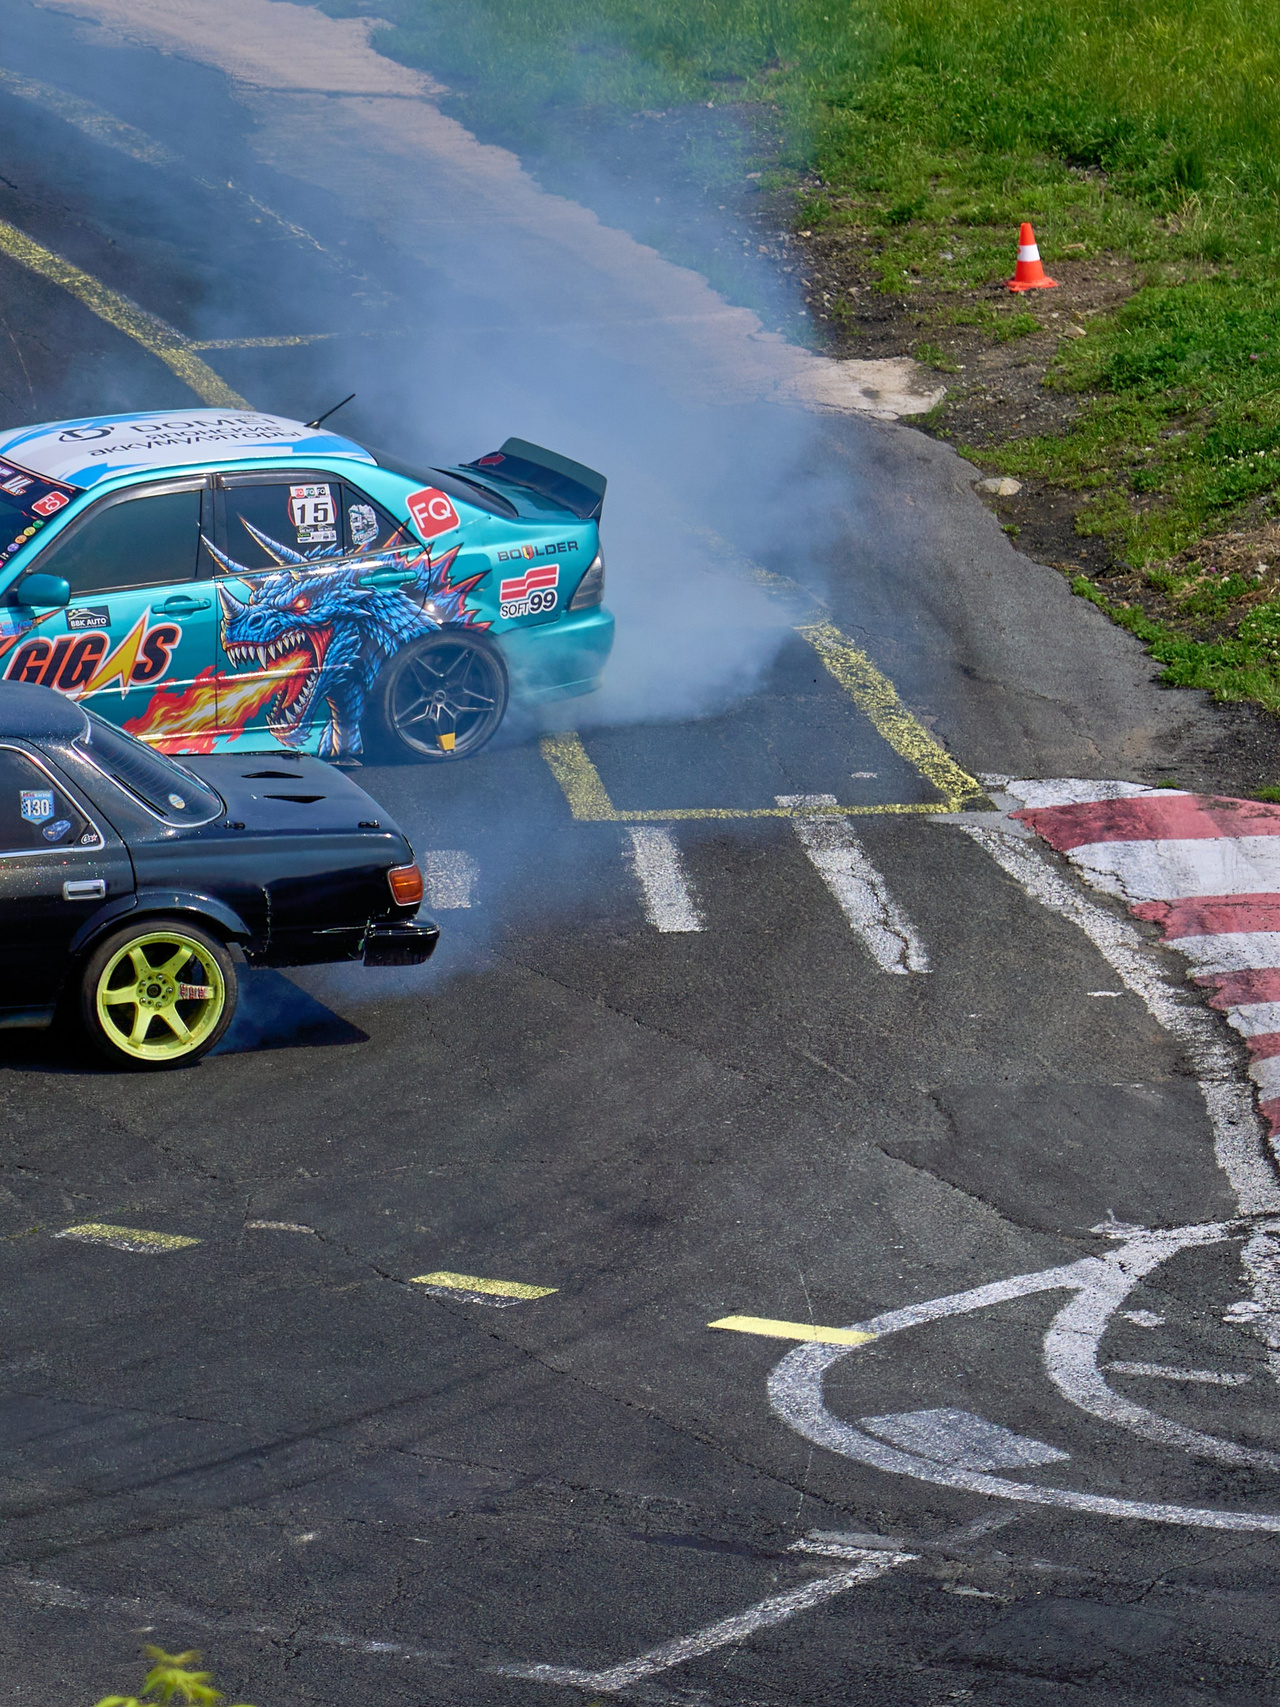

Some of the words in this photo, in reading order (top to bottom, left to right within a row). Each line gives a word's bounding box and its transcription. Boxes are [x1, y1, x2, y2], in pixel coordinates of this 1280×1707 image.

[130, 418, 278, 433] DOMEI
[39, 496, 61, 511] FQ
[297, 502, 328, 523] 15
[413, 498, 452, 528] FQ
[70, 619, 86, 627] BBK
[87, 617, 106, 626] AUTO
[26, 799, 49, 816] 130
